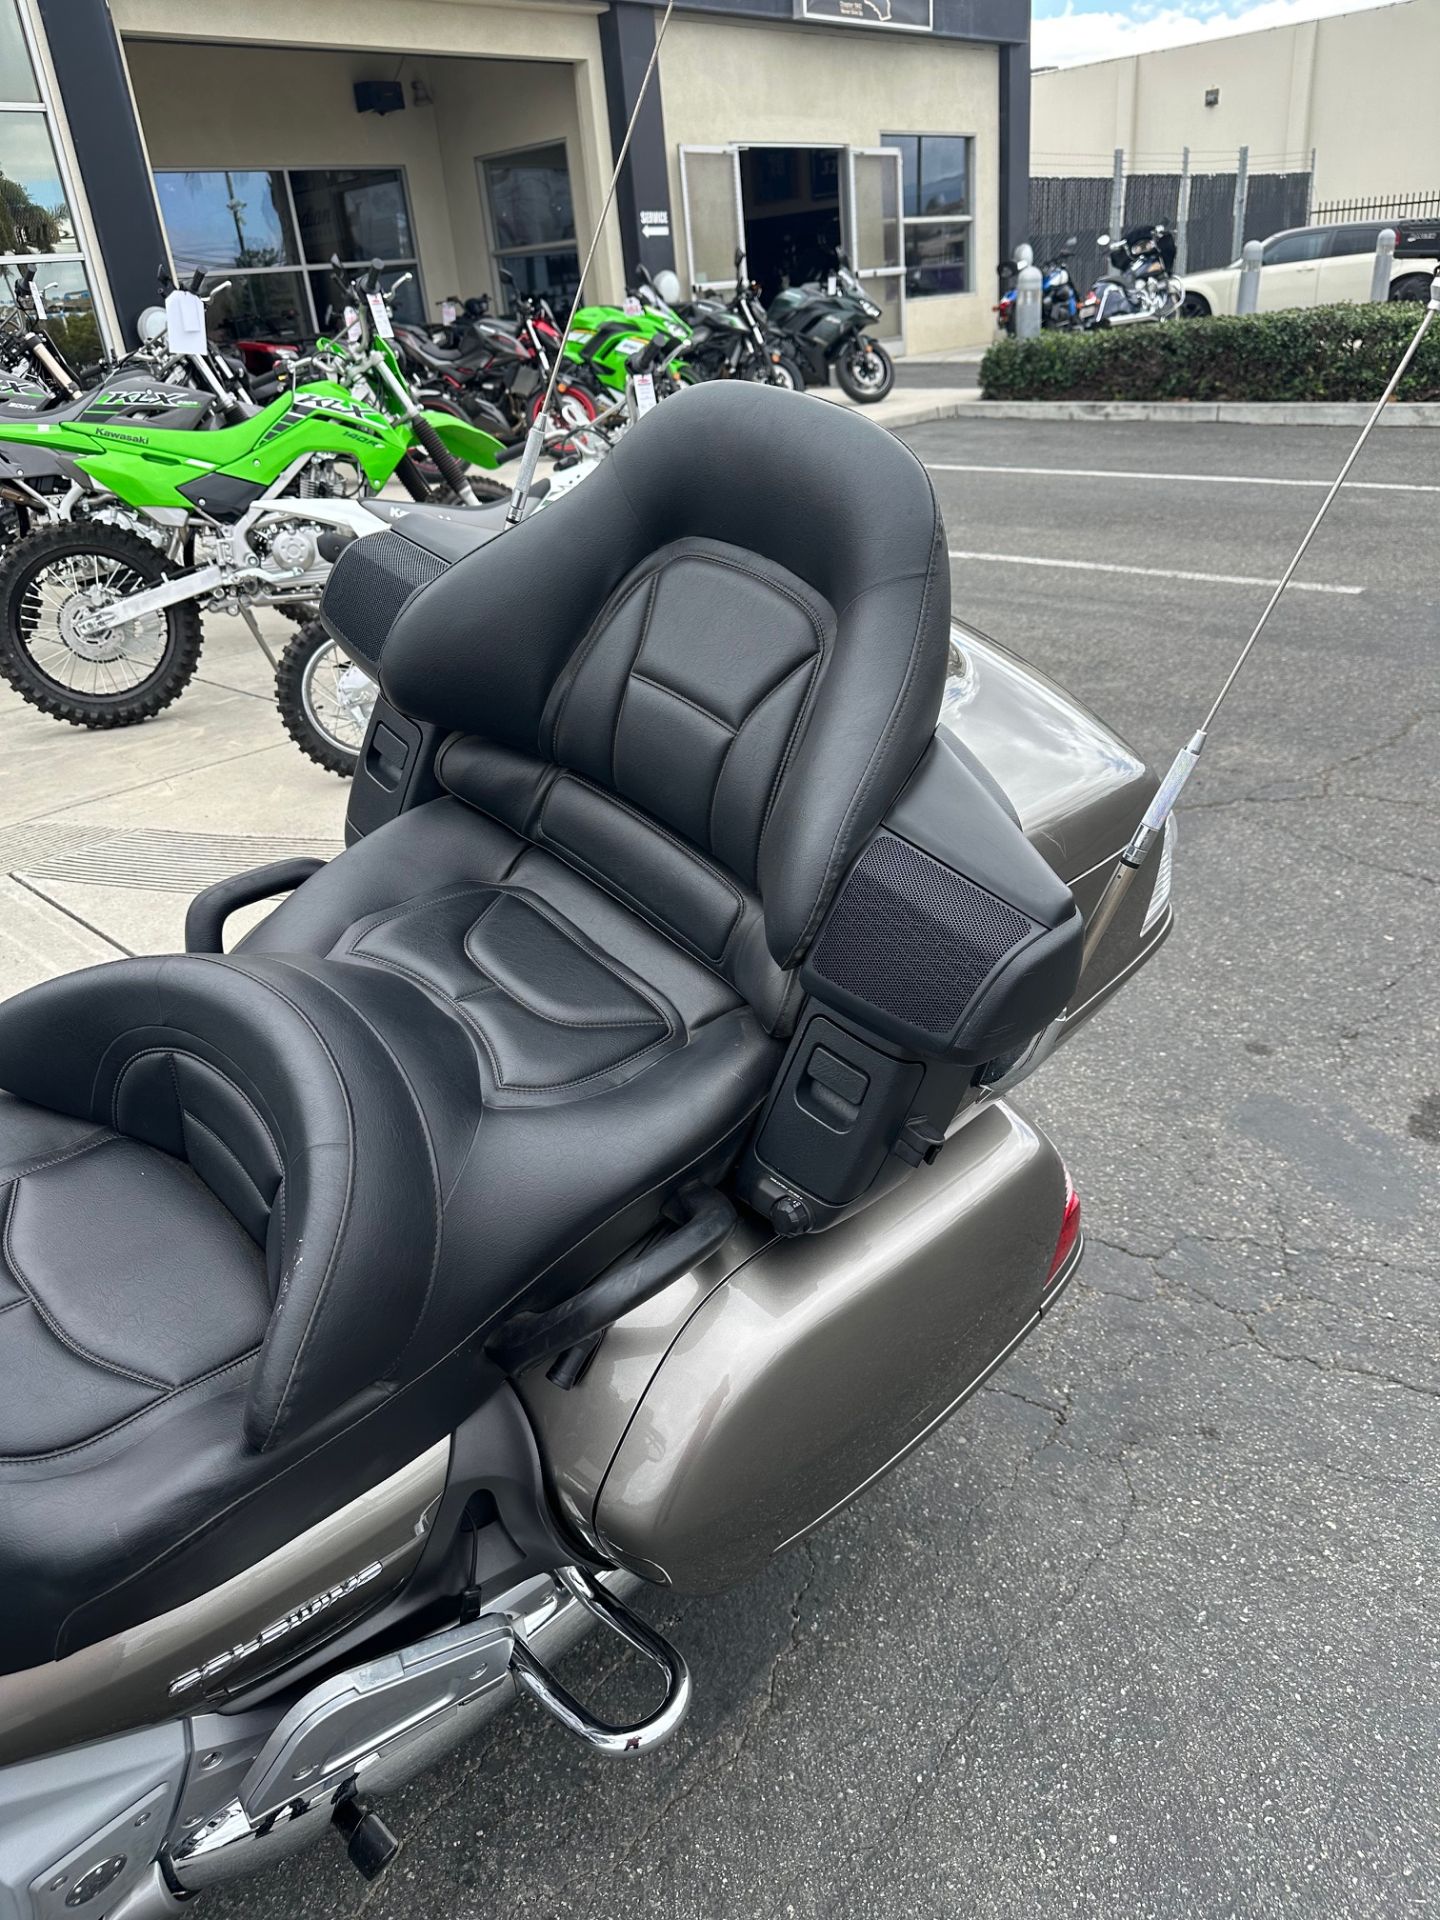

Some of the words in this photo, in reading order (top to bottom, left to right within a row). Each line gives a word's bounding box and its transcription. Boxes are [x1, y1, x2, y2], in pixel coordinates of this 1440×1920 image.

[640, 211, 668, 224] SERVICE
[106, 391, 189, 407] KLX
[297, 395, 373, 418] KLX
[95, 427, 150, 445] Kawasaki
[342, 431, 379, 447] 140R
